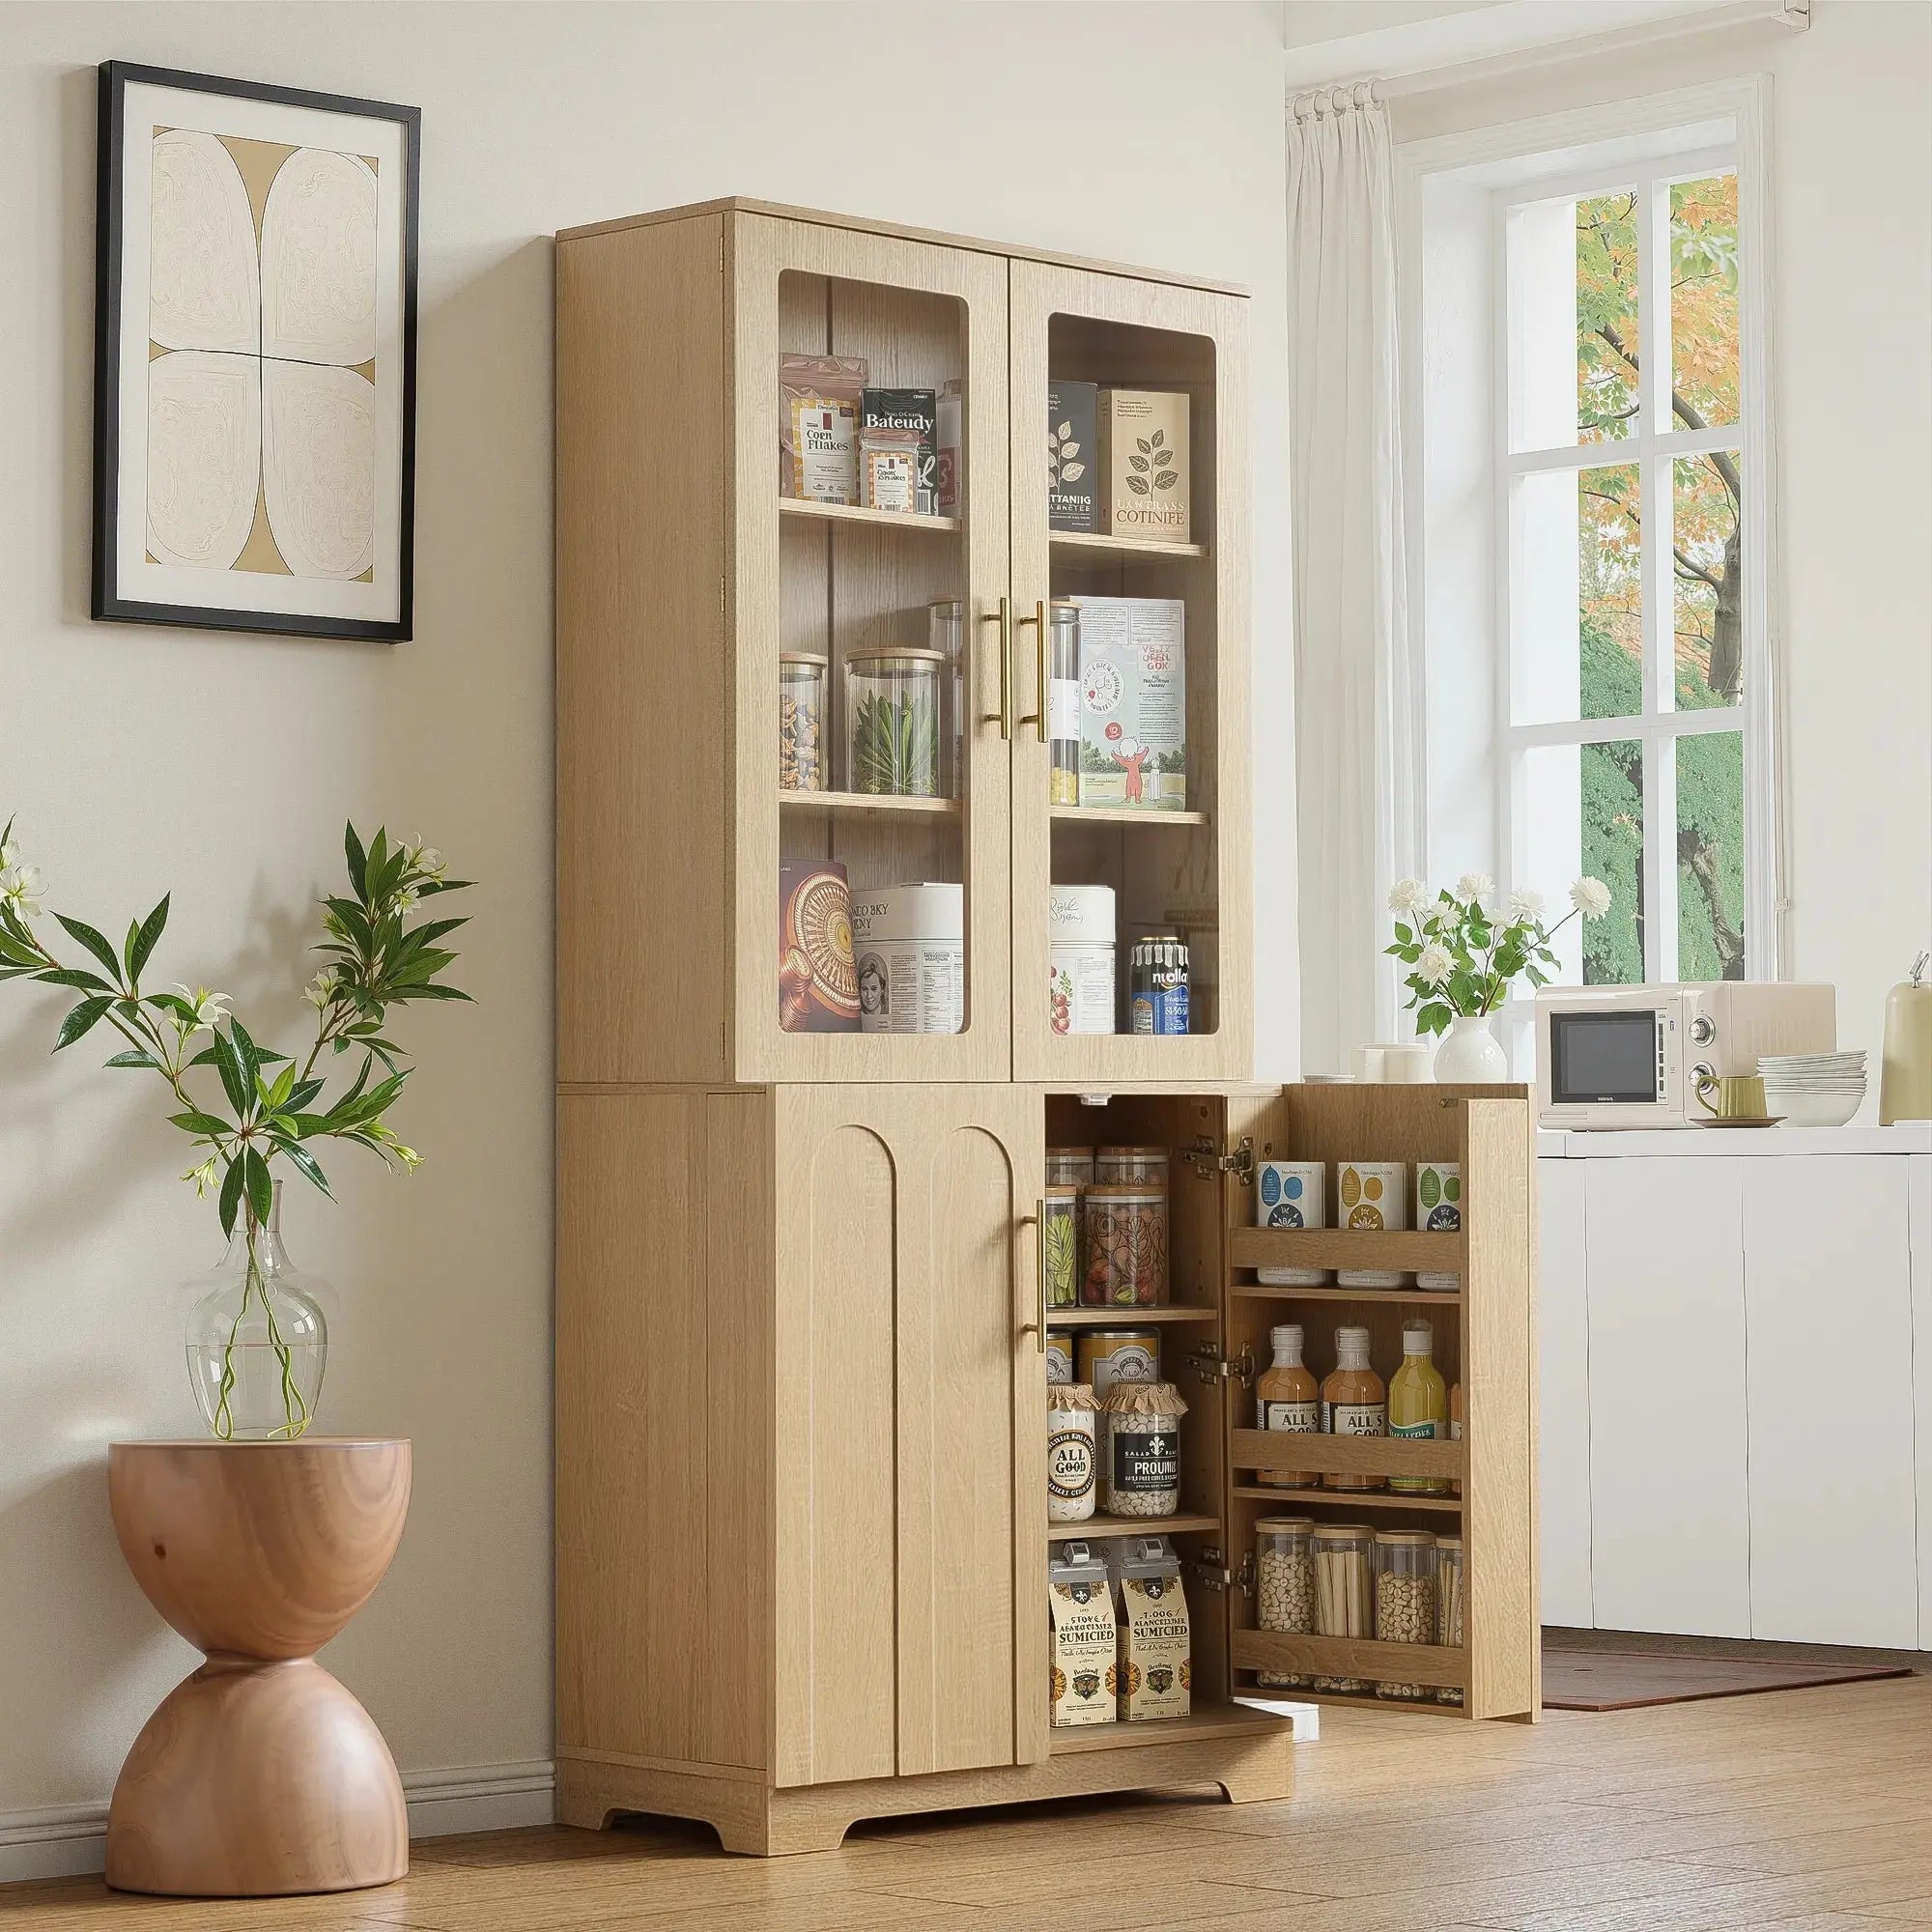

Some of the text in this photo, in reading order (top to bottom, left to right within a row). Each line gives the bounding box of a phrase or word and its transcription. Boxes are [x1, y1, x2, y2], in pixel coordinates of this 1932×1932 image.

[1282, 1413, 1309, 1426] ALL
[1347, 1415, 1374, 1428] ALL
[1057, 1448, 1086, 1462] ALL
[1055, 1461, 1087, 1474] GOOD
